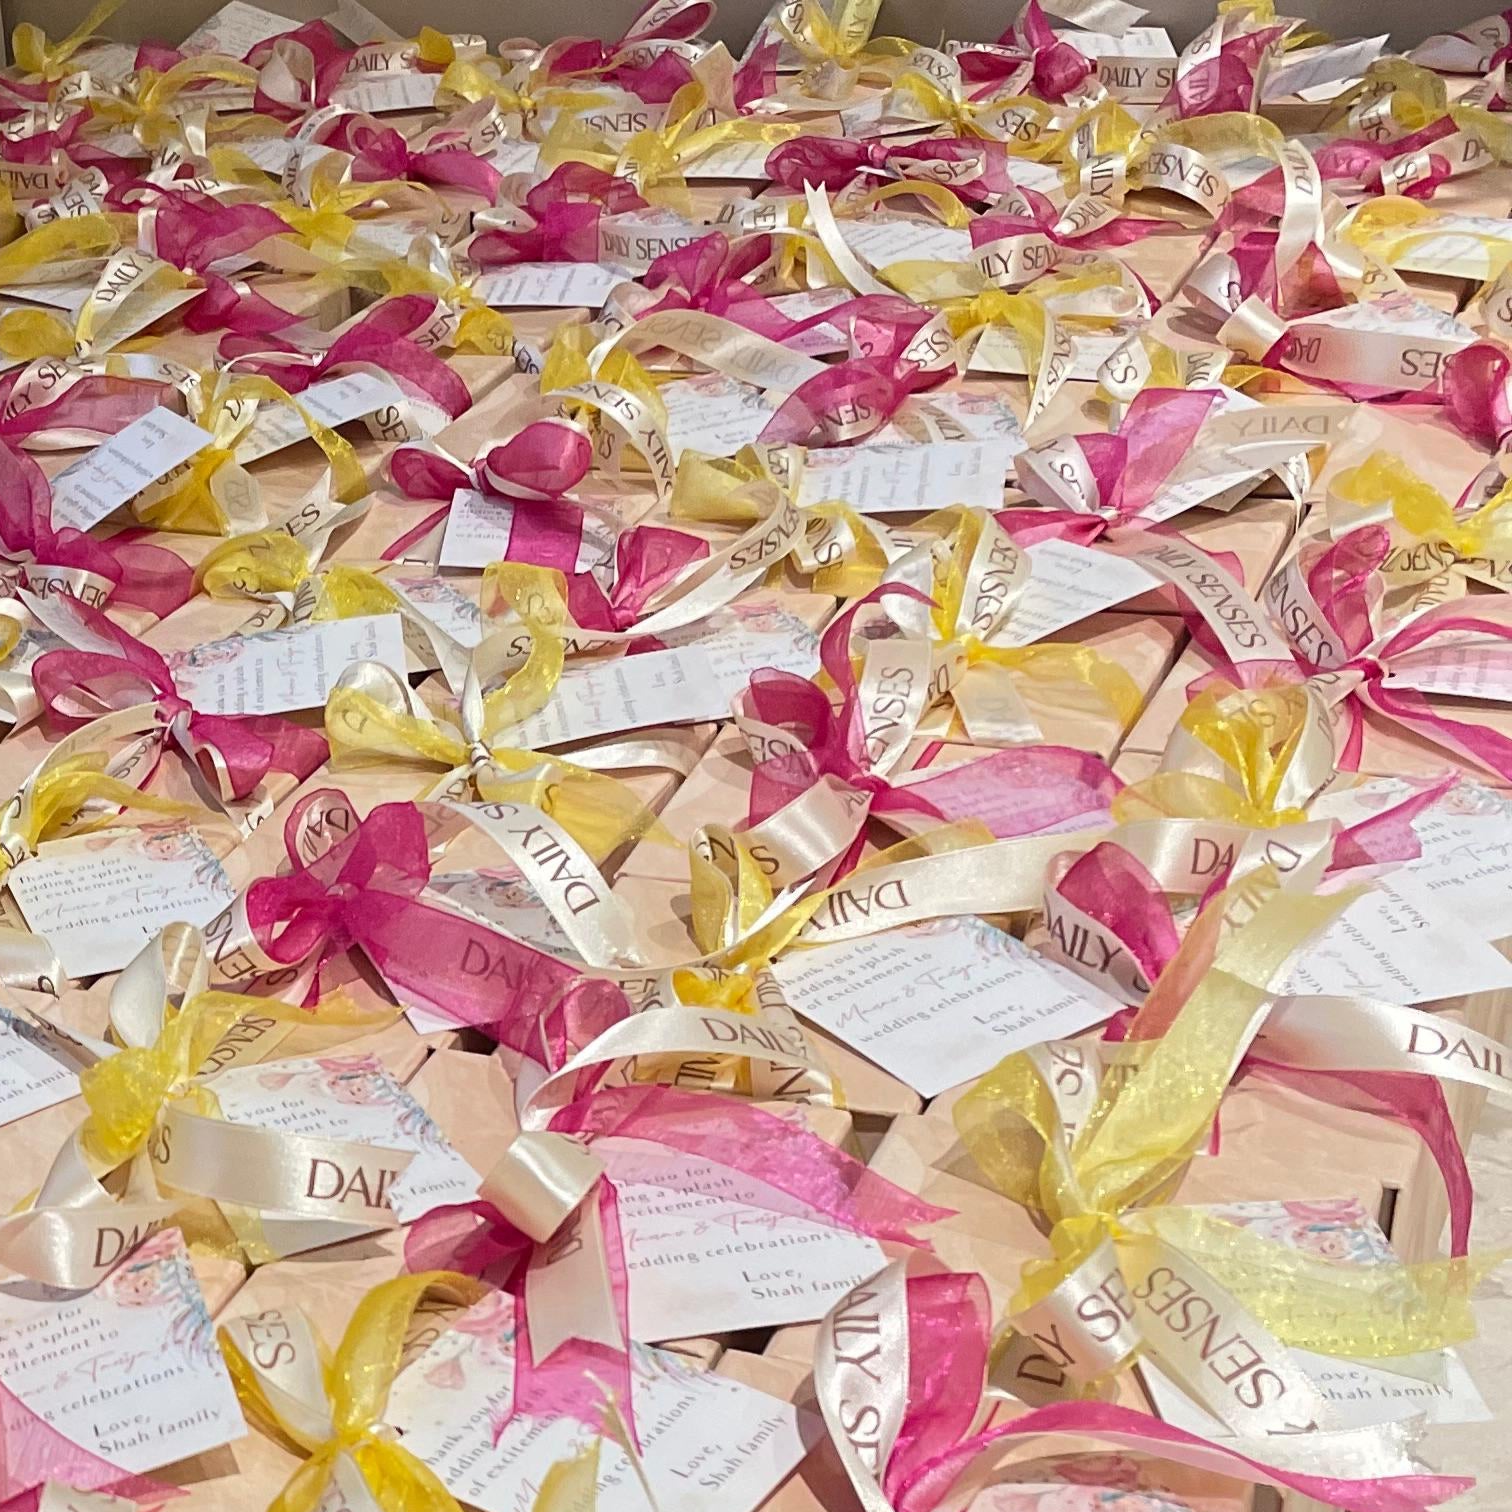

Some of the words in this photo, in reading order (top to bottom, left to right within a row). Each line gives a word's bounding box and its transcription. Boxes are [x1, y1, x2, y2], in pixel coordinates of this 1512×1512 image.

[346, 53, 393, 73] DAILY
[1098, 66, 1146, 88] DAILY
[95, 256, 145, 302] DAILY
[1187, 573, 1267, 649] SENSES
[1271, 567, 1332, 667] ENSES
[507, 824, 601, 916] DAILY
[41, 914, 111, 936] wedding
[114, 894, 211, 925] celebrations
[792, 975, 843, 1002] adding
[861, 946, 907, 976] splash
[825, 953, 855, 978] you
[856, 940, 879, 959] for
[806, 998, 823, 1011] of
[826, 961, 912, 1002] excitement
[915, 952, 933, 967] to
[858, 1011, 929, 1044] wedding
[930, 967, 1024, 1014] celebrations
[973, 1002, 1024, 1026] Love,
[991, 1012, 1034, 1038] Shah
[1037, 993, 1090, 1022] family
[26, 1070, 73, 1091] family
[409, 1178, 468, 1199] family
[687, 1164, 714, 1178] for
[705, 1230, 833, 1259] celebrations
[741, 1267, 803, 1284] Love,
[749, 1284, 806, 1300] Shah
[42, 1317, 103, 1350] splash
[60, 1364, 186, 1416] celebrations
[1381, 1385, 1455, 1400] family
[92, 1413, 154, 1438] Love,
[98, 1431, 154, 1455] Shah
[157, 1407, 224, 1438] family
[443, 1437, 493, 1487] adding
[671, 1443, 724, 1480] Love,
[698, 1459, 735, 1491] Shah
[736, 1413, 787, 1467] family
[468, 1476, 487, 1498] of
